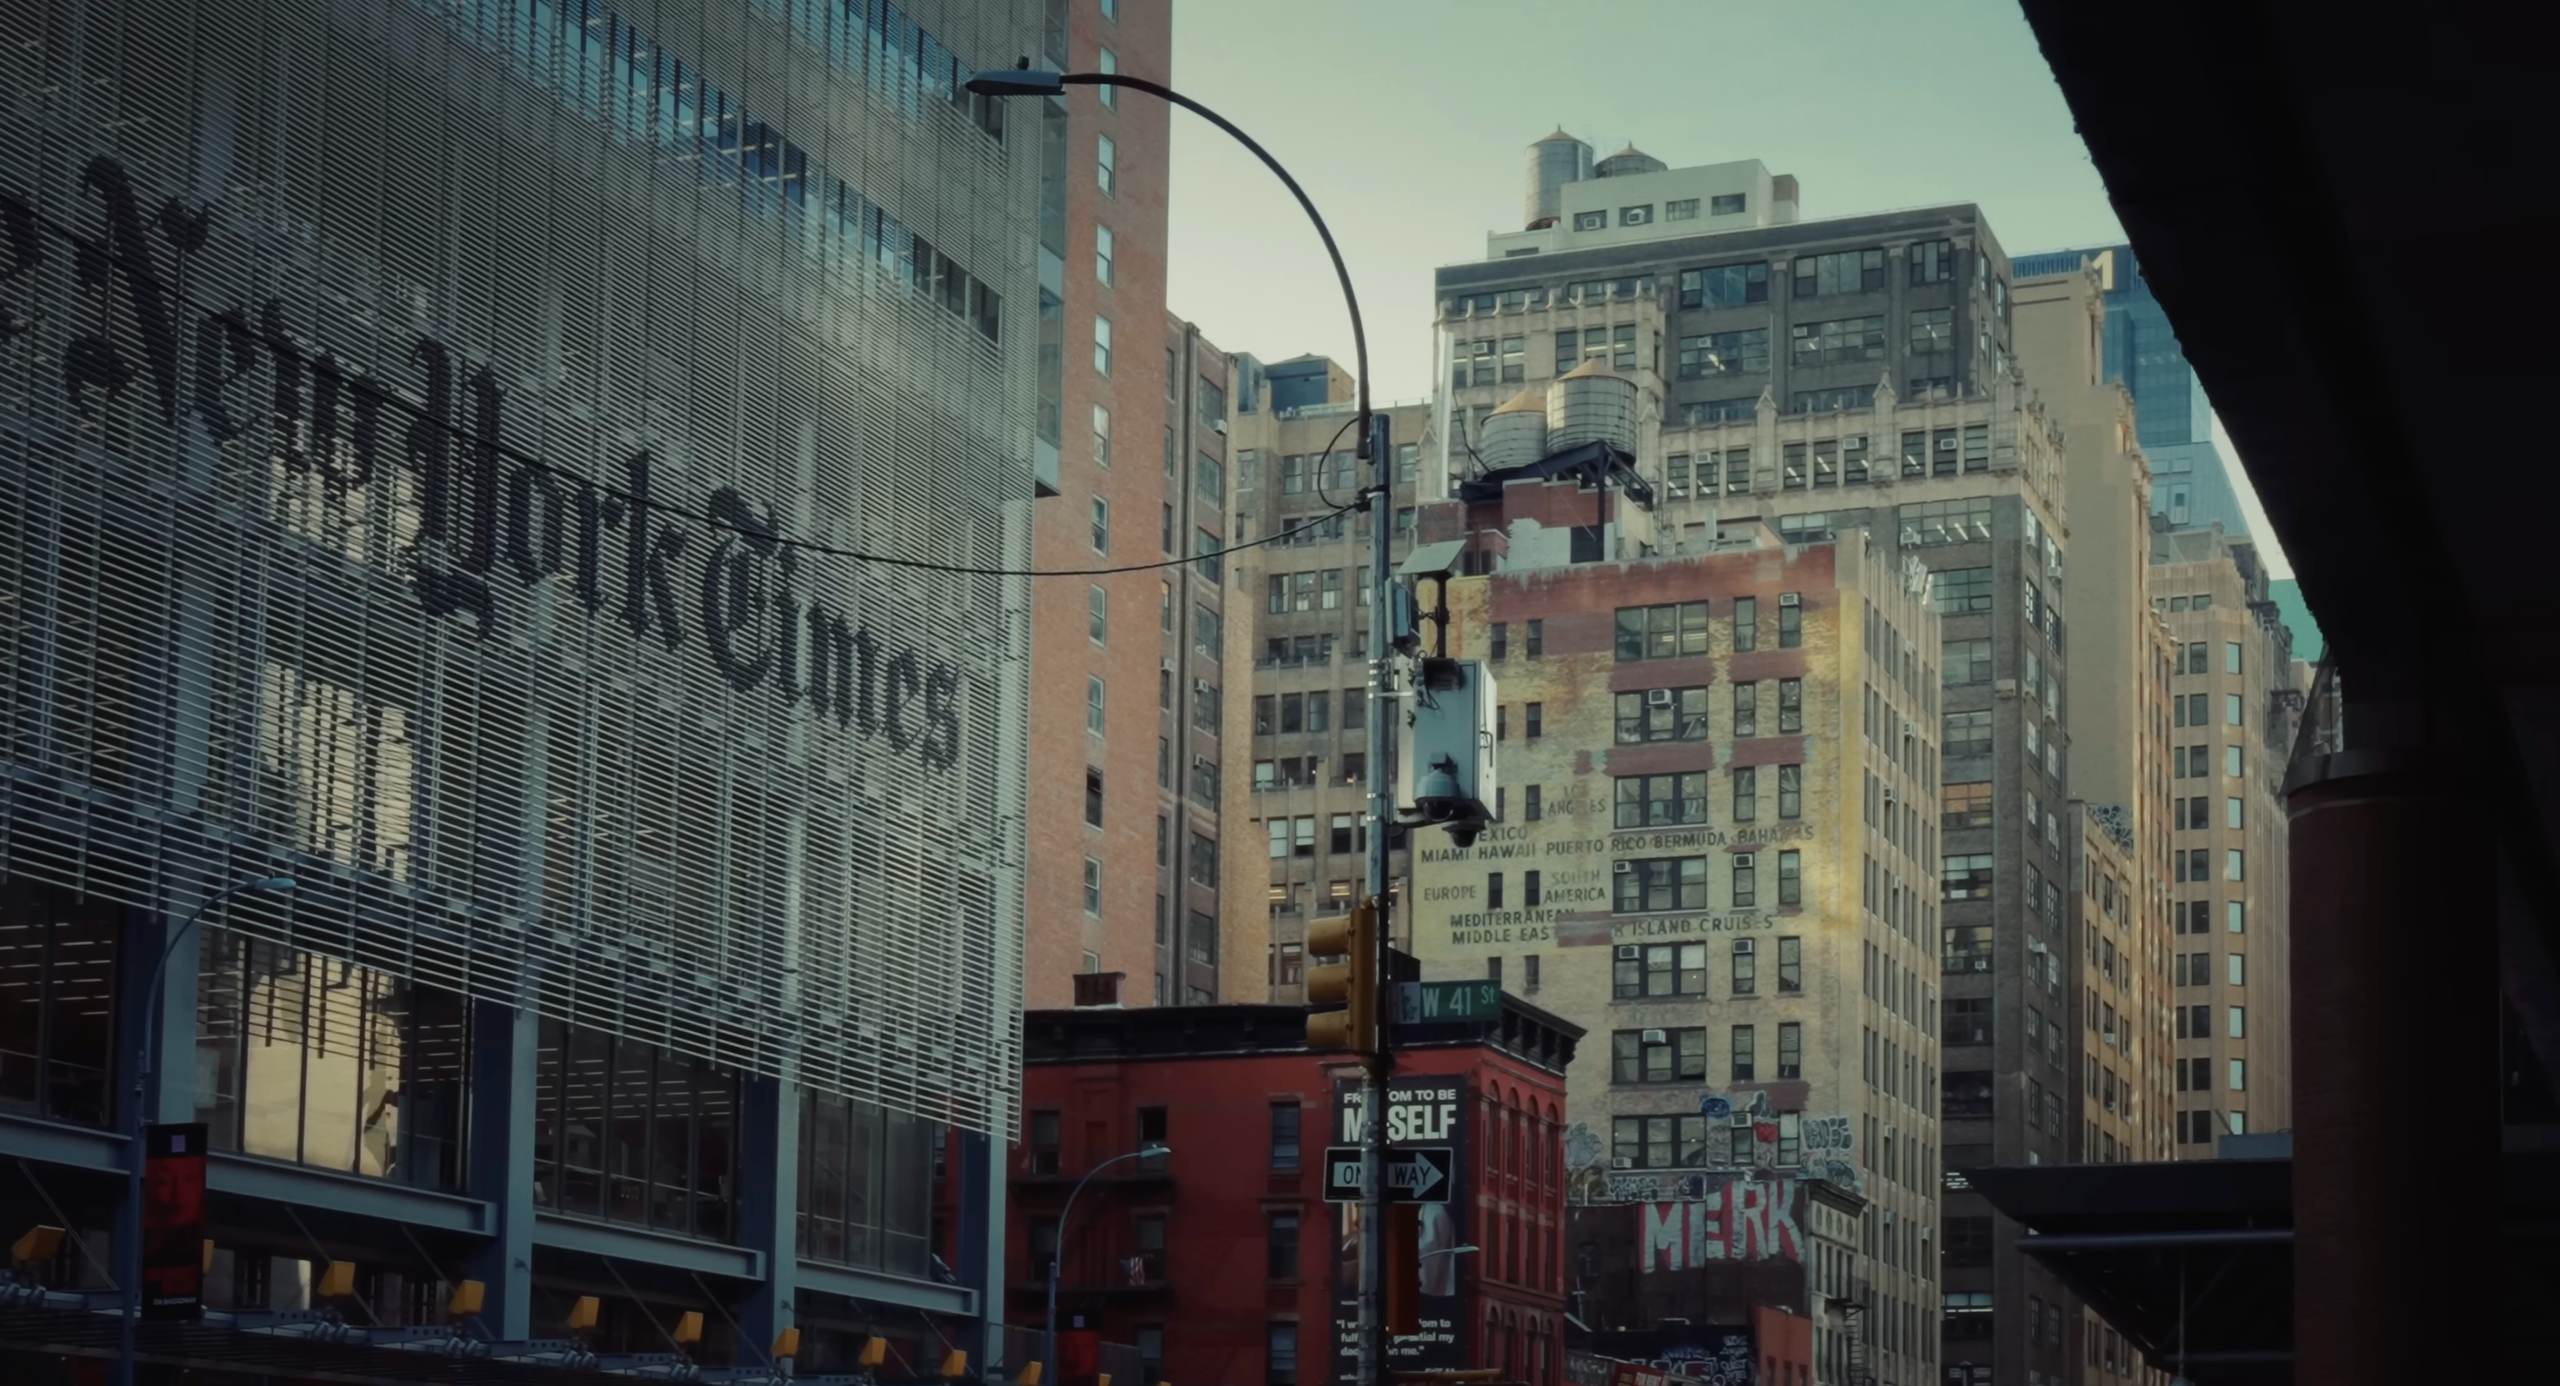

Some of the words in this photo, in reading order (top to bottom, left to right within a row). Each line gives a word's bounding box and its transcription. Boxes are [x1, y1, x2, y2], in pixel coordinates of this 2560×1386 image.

[64, 152, 376, 490] New
[401, 337, 690, 655] York
[701, 484, 961, 782] Times
[1548, 799, 1606, 817] ANGES
[1478, 826, 1528, 842] EXICO
[1421, 849, 1469, 863] MIAMI
[1478, 844, 1536, 859] HAWAII
[1546, 839, 1604, 855] PUERTO
[1611, 836, 1647, 851] RICO
[1654, 830, 1726, 848] BERMUDA
[1424, 885, 1476, 900] EUROPE
[1543, 887, 1606, 905] AMERICA
[1452, 929, 1511, 944] MIDDLE
[1520, 927, 1553, 942] EAS
[1633, 919, 1691, 936] ISLAND
[1422, 987, 1439, 1018] W
[1449, 986, 1472, 1017] 41
[1481, 986, 1496, 1005] St
[1343, 1089, 1412, 1104] FROM
[1415, 1089, 1434, 1102] TO
[1438, 1088, 1457, 1101] BE
[1342, 1104, 1457, 1143] MSELF
[1395, 1165, 1432, 1186] WAY
[1636, 1180, 1806, 1274] MERK
